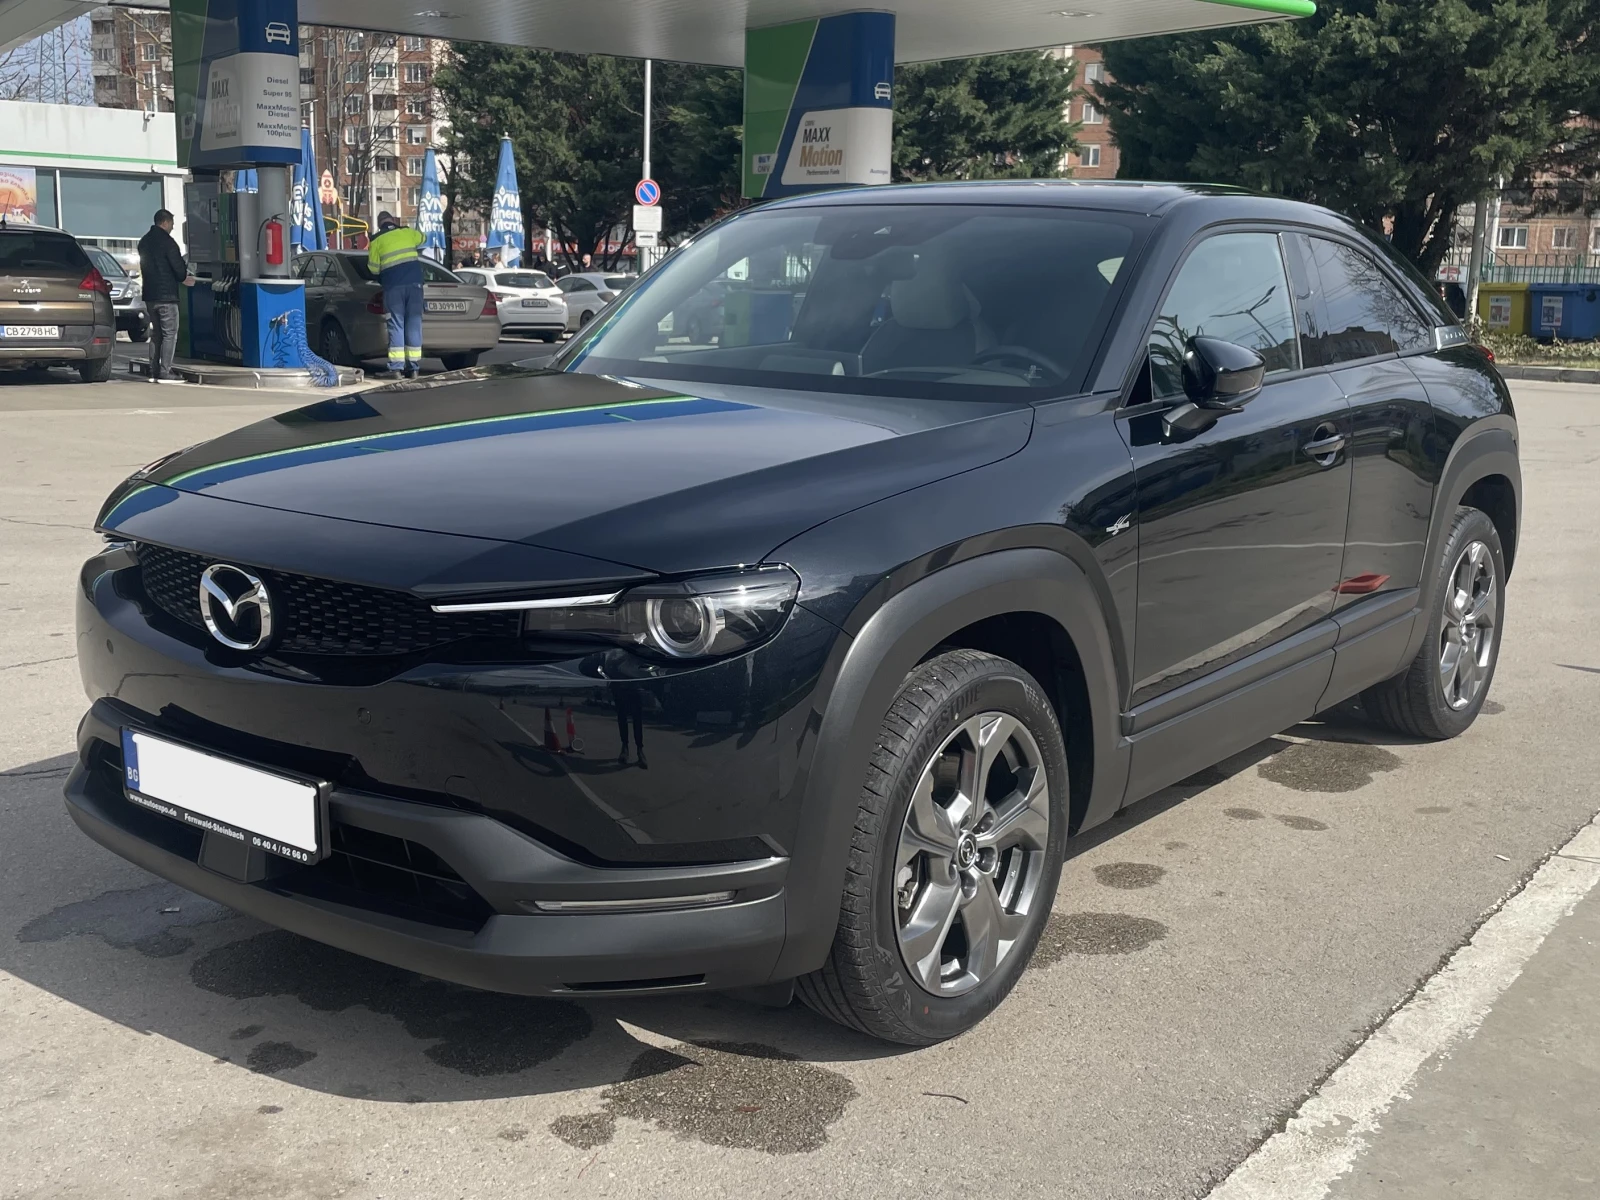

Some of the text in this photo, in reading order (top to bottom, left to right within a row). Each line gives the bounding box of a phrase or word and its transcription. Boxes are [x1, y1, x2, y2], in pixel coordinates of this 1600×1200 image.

[266, 76, 289, 85] Diesel
[211, 78, 230, 100] MAXX
[262, 89, 283, 98] Super
[256, 103, 298, 112] MaxxMotion
[267, 110, 290, 118] Diesel
[256, 122, 298, 131] MaxxMotion
[266, 129, 292, 138] 100plus
[802, 127, 831, 143] MAXX
[799, 144, 843, 168] Motion
[428, 302, 438, 310] CB
[6, 327, 57, 336] CB 2798 HC
[127, 766, 139, 782] BG
[129, 793, 177, 817] www.autoexpo.de
[184, 812, 245, 841] Fernwald-Steinbach
